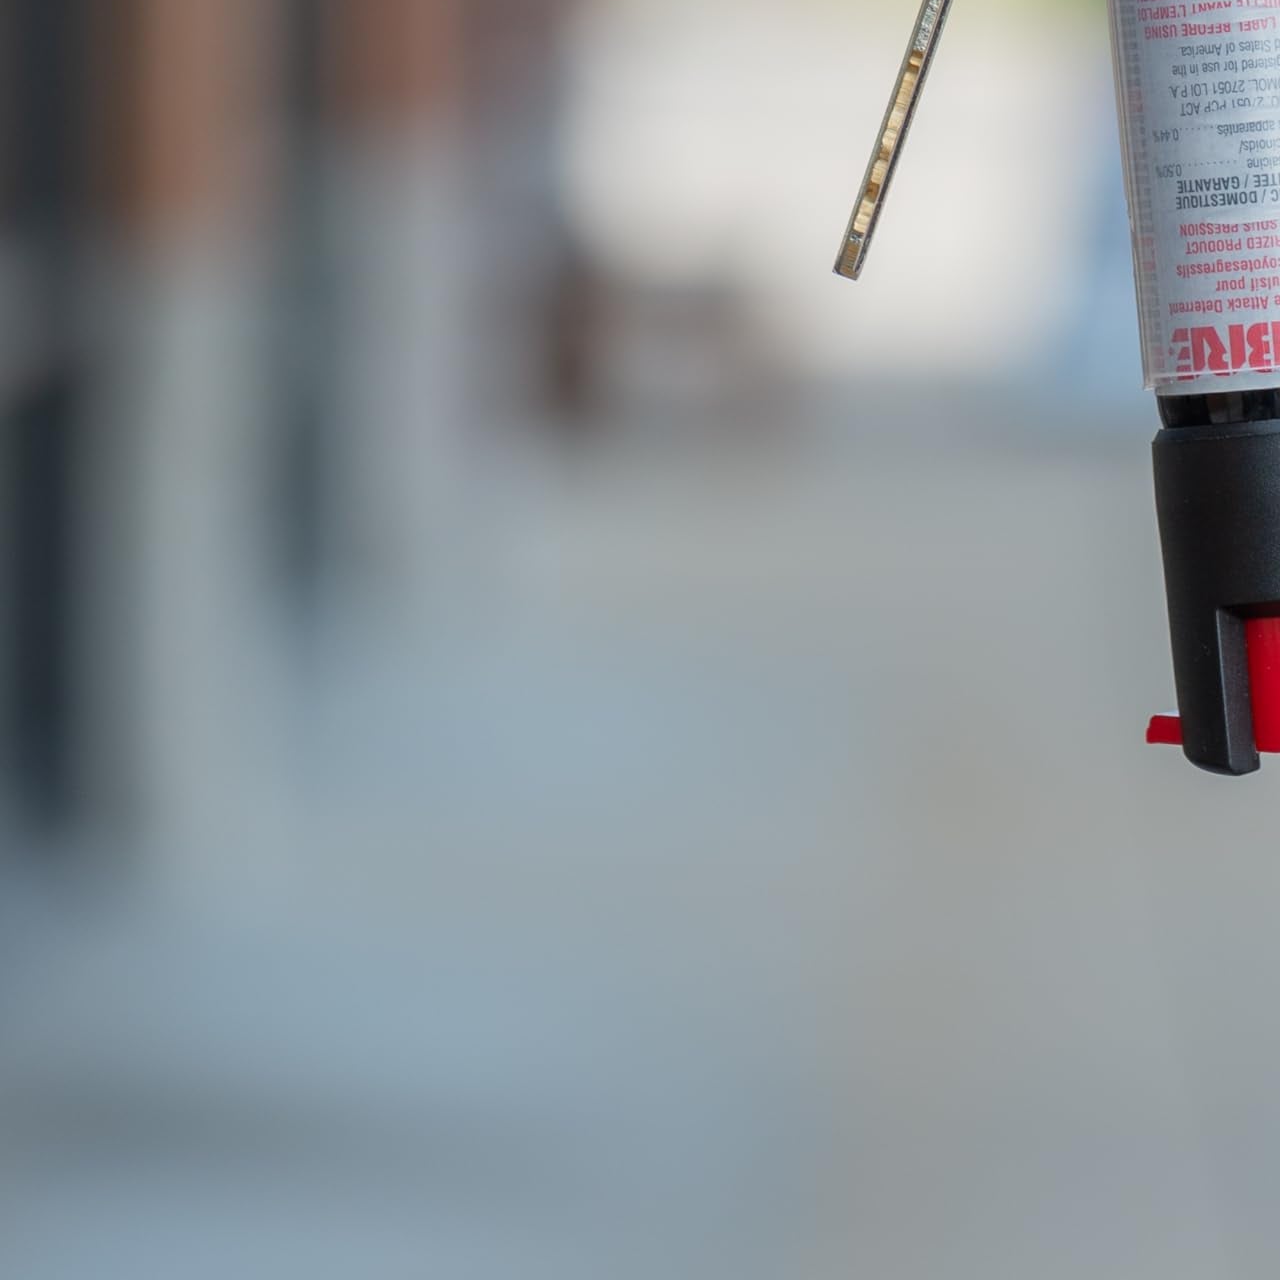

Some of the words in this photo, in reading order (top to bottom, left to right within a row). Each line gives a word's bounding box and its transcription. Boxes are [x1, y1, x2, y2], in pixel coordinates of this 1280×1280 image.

[1181, 22, 1230, 37] BEFORE
[1240, 17, 1276, 32] LABEL
[1144, 25, 1177, 39] USING
[1225, 42, 1235, 56] of
[1239, 40, 1270, 52] States
[1172, 65, 1186, 78] the
[1190, 64, 1199, 76] in
[1202, 62, 1220, 75] use
[1223, 60, 1237, 74] for
[1190, 83, 1208, 96] LOI
[1212, 80, 1244, 94] 27051
[1180, 102, 1200, 116] ACT
[1217, 119, 1275, 137] apparentés
[1177, 176, 1239, 193] GARANTIE
[1244, 174, 1249, 188] /
[1176, 190, 1257, 209] DOMESTIQUE
[1261, 189, 1266, 204] /
[1179, 218, 1238, 236] PRESSION
[1243, 219, 1277, 232] SOUS
[1186, 239, 1241, 254] PRODUCT
[1216, 276, 1245, 292] pour
[1169, 299, 1222, 316] Deterrent
[1227, 296, 1268, 312] Attack
